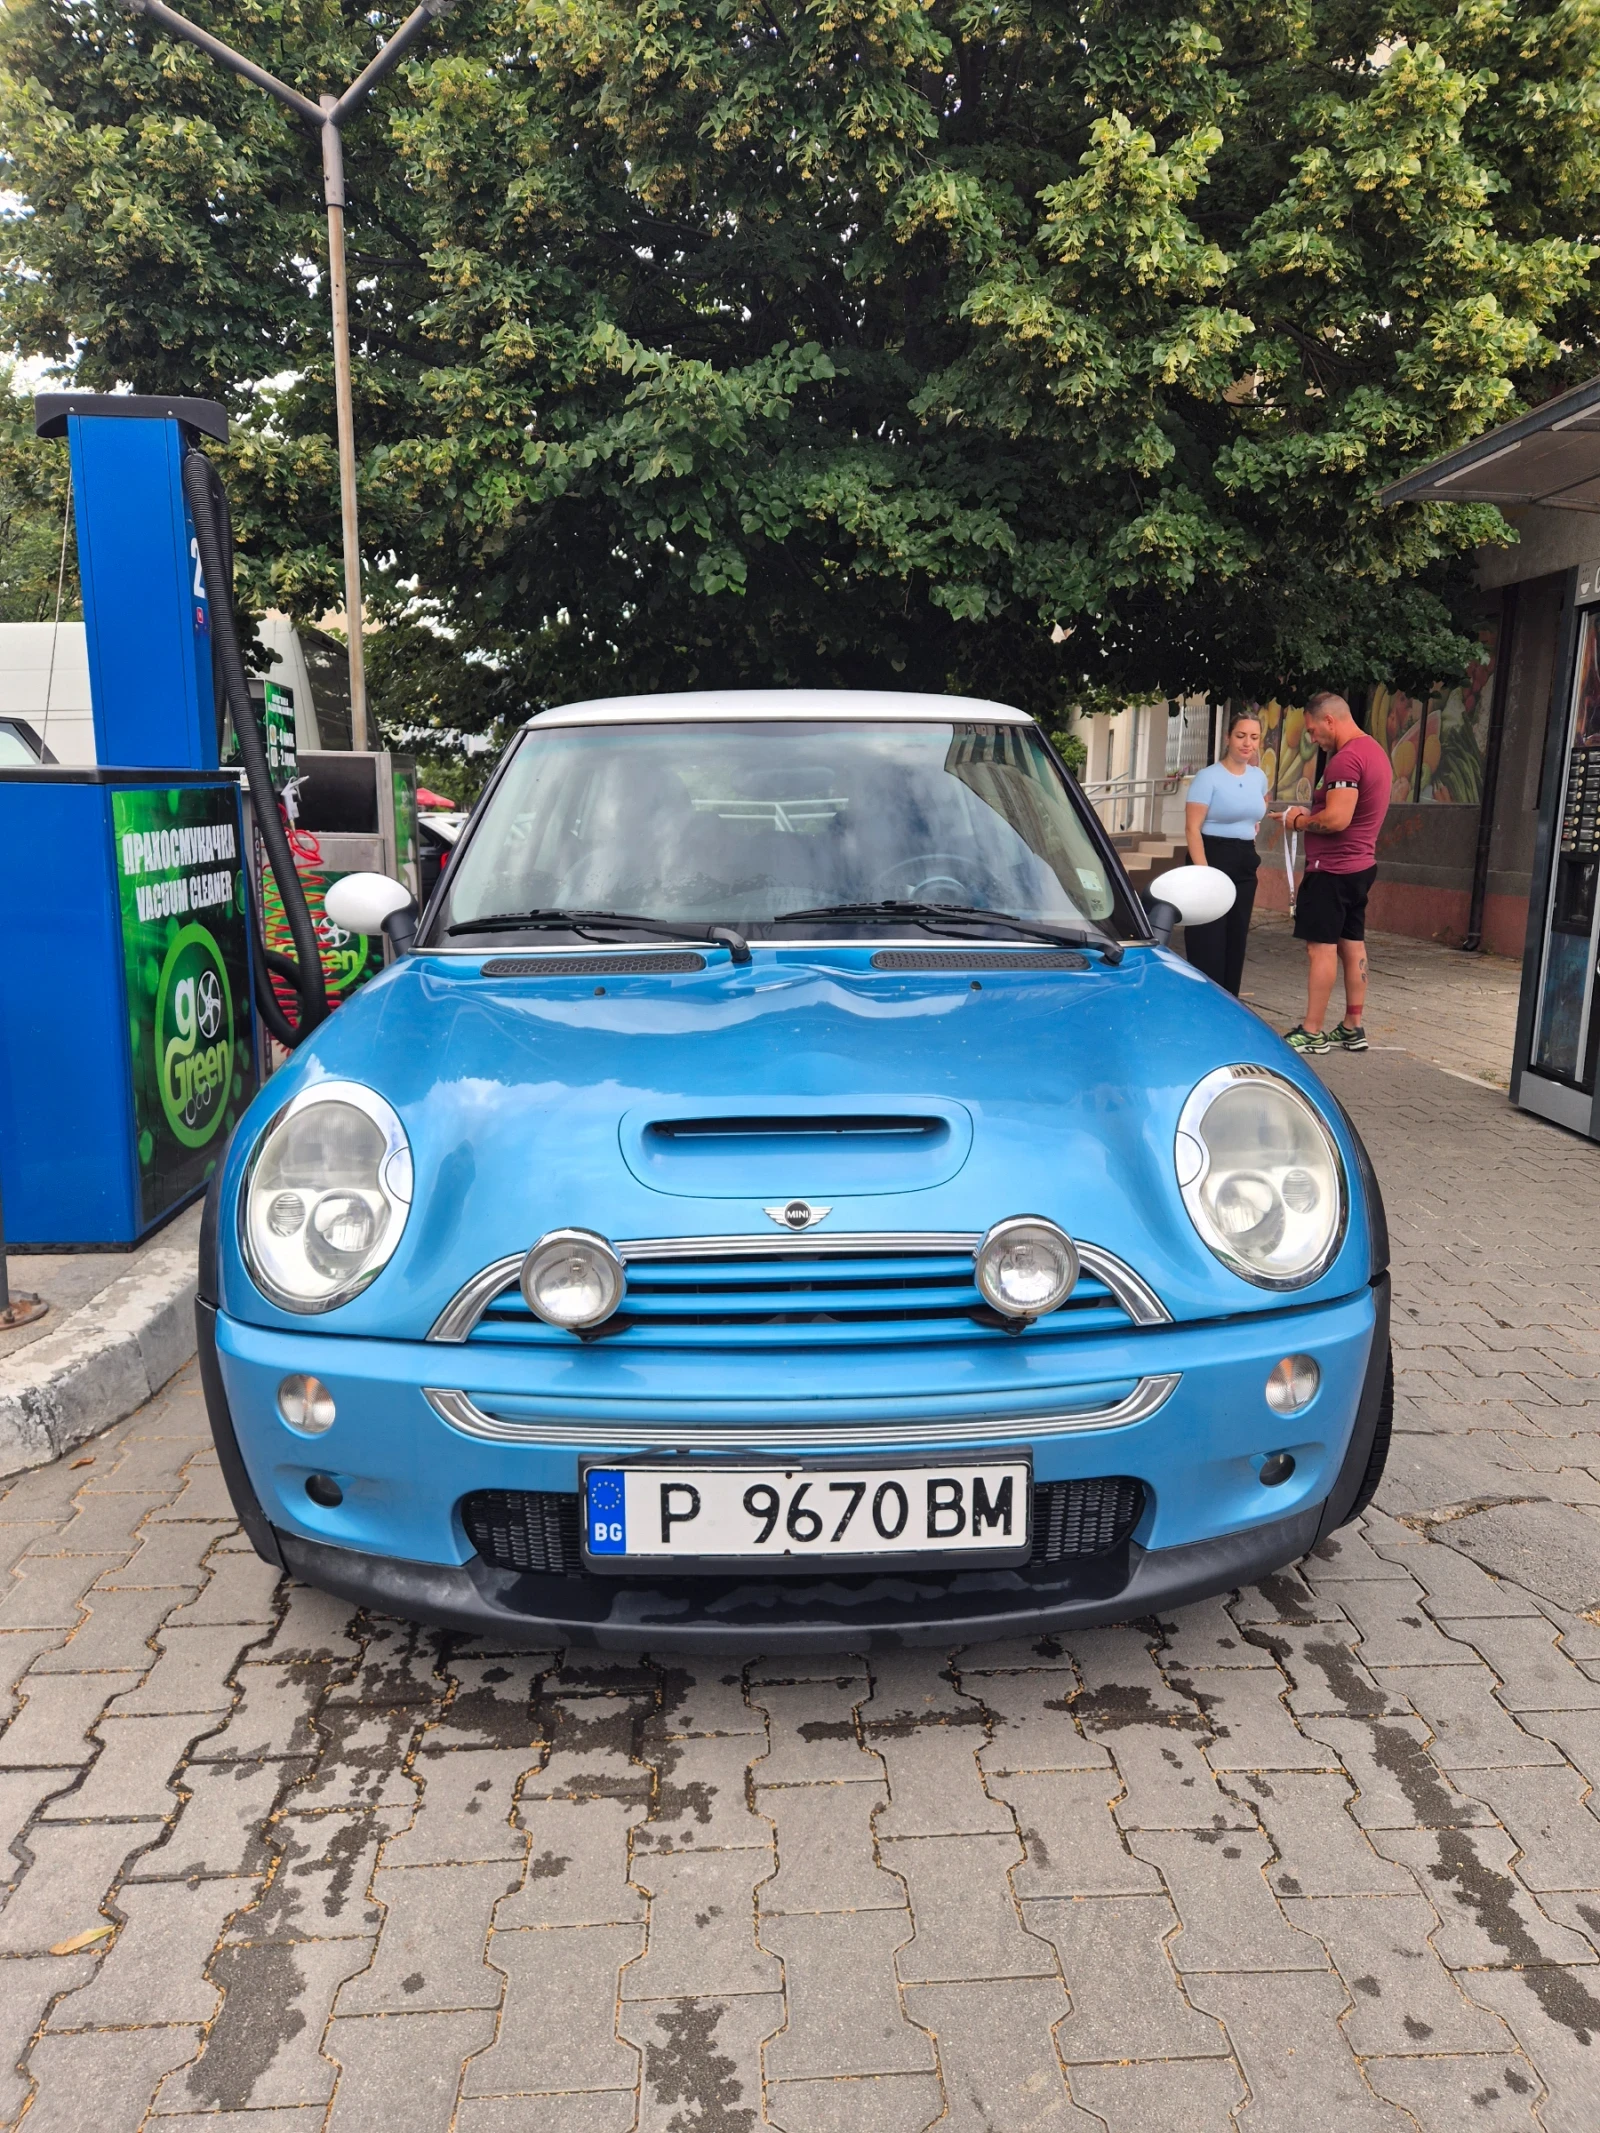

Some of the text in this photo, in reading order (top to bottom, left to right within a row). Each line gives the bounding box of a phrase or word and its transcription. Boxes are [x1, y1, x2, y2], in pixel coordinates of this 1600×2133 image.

[122, 824, 236, 875] ПРАХОСМУКАЧКА
[136, 870, 232, 922] VACUUM CLEANER
[163, 1038, 230, 1116] Green
[787, 1209, 809, 1219] MINI
[594, 1523, 623, 1543] BG
[658, 1475, 1014, 1545] P 9670 BM
